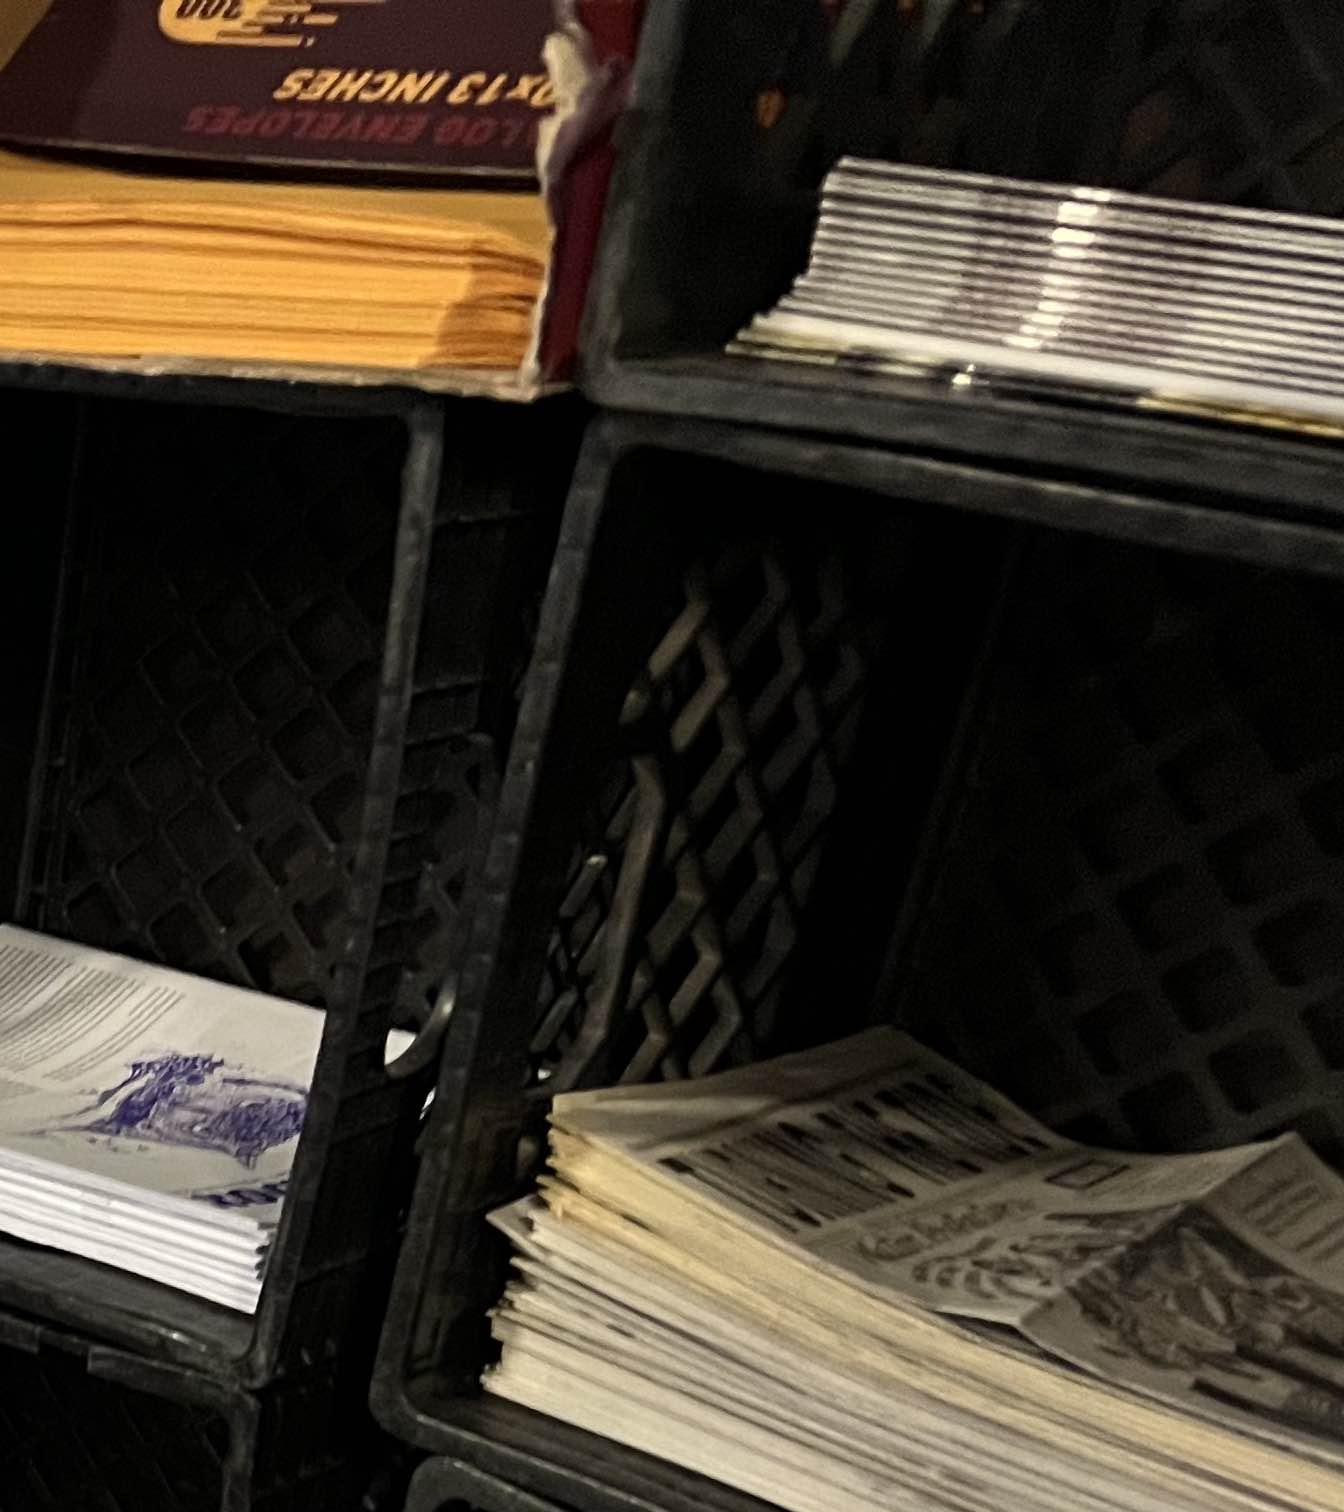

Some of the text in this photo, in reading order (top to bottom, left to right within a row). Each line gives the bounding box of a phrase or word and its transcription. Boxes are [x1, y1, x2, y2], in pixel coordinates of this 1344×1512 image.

[272, 67, 451, 104] INCHES
[181, 104, 540, 149] LOG ENVELOPES
